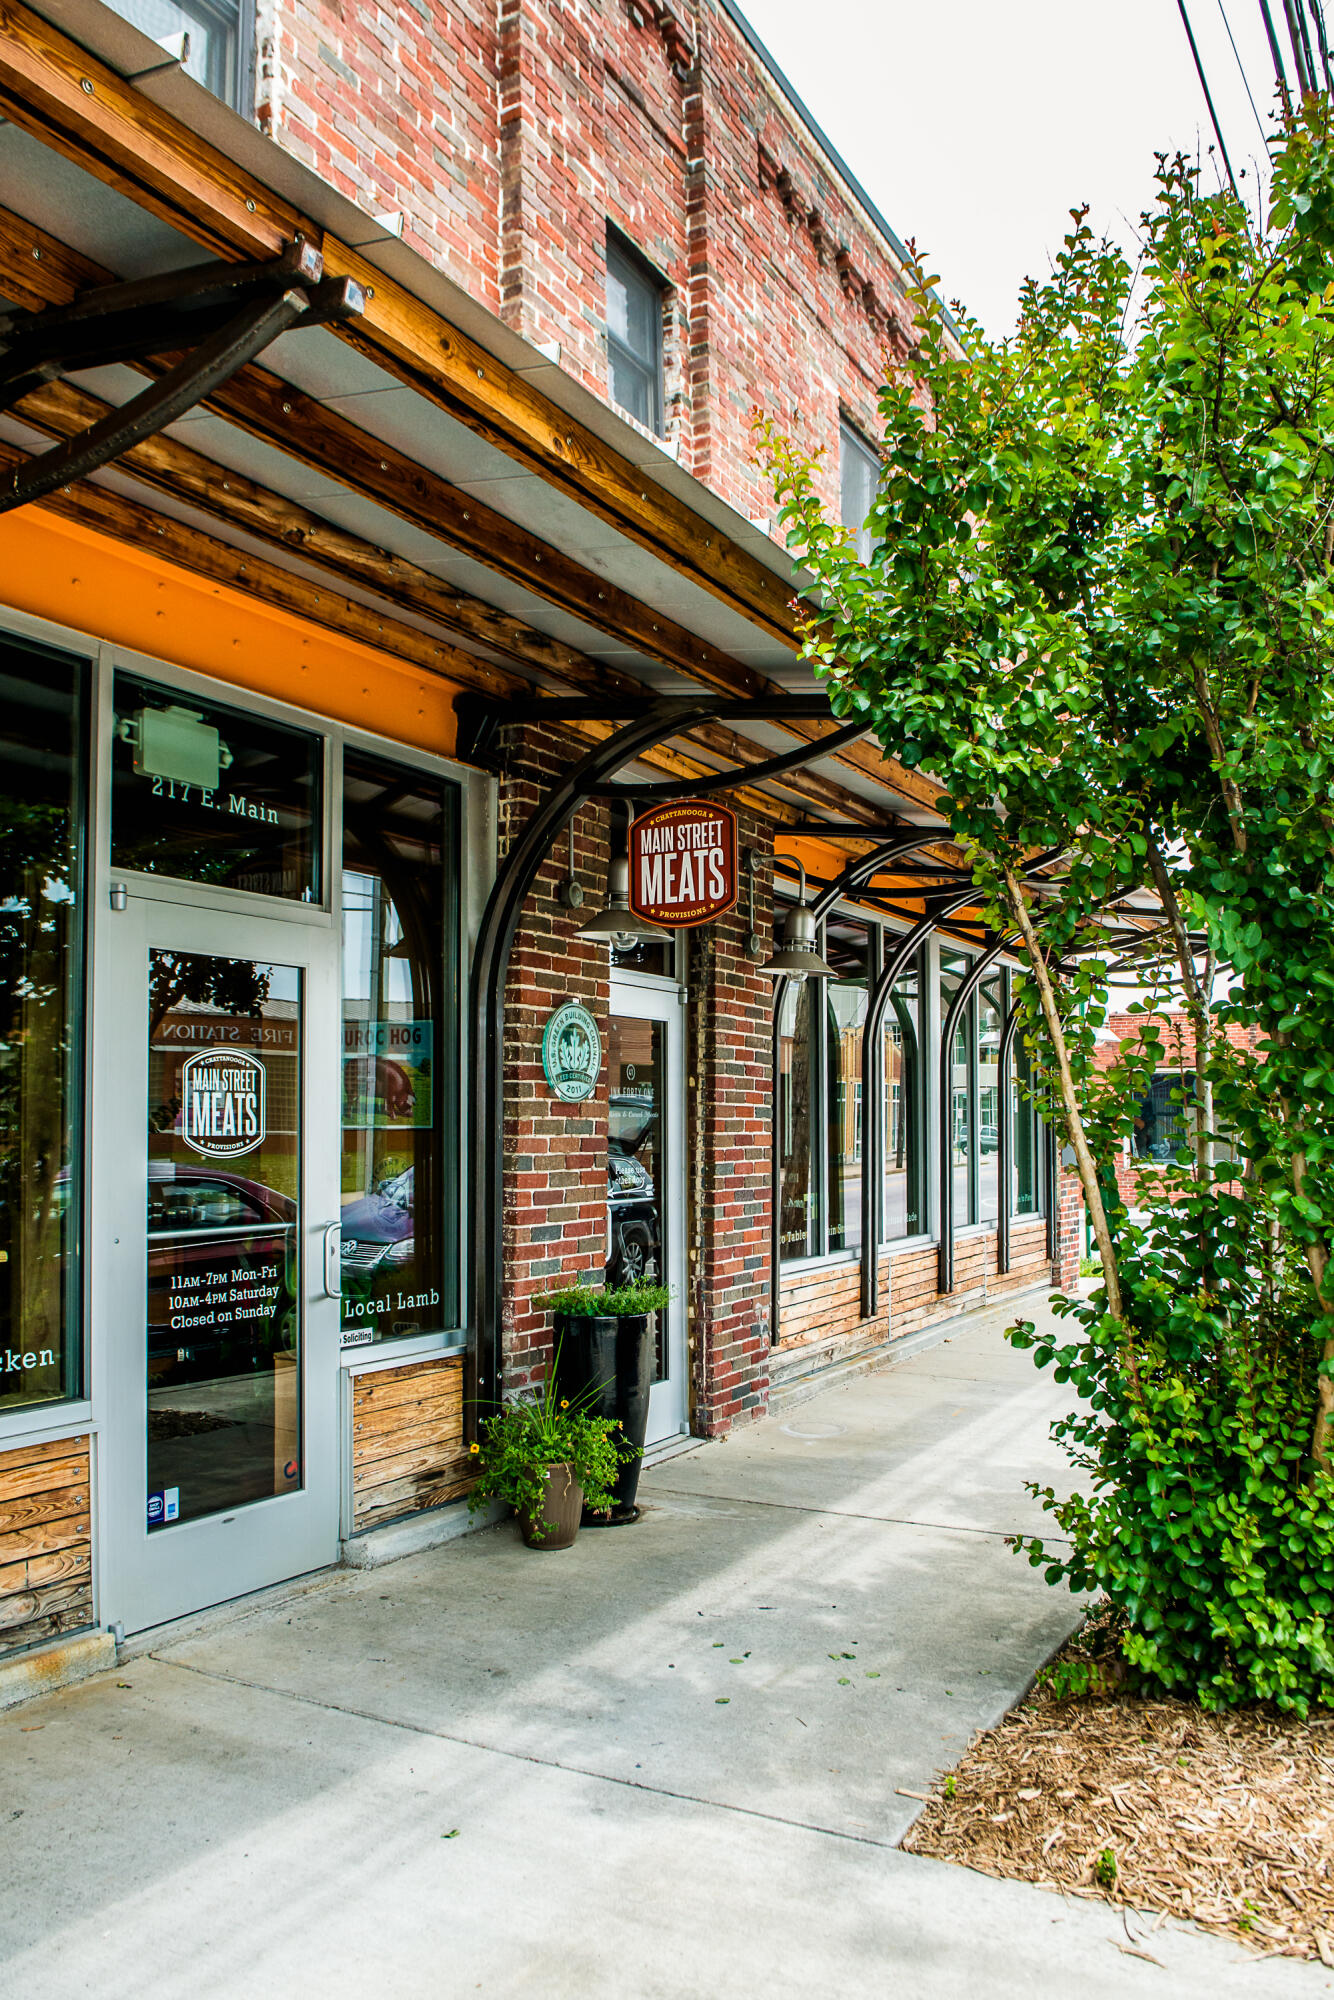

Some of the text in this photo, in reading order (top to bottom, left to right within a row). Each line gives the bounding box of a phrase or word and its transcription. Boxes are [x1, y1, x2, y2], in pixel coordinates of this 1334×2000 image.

[152, 775, 279, 824] 217 E. Main
[655, 809, 707, 823] CHATTANOOGA
[640, 820, 723, 854] MAIN STREET
[641, 847, 725, 906] MEATS
[659, 906, 707, 919] PROVISIONS
[341, 1027, 422, 1046] UROC HOG
[551, 1019, 564, 1047] GREEN
[564, 1011, 590, 1029] BUILDING
[589, 1029, 597, 1071] COUNCIL
[204, 1055, 246, 1066] CHATTANOOGA
[192, 1068, 257, 1092] MAIN STREET
[566, 1085, 582, 1094] 2011
[192, 1092, 257, 1137] MEATS
[206, 1141, 244, 1150] PROVISIONS
[170, 1265, 278, 1290] 11AM-7PM Mon-Fri
[169, 1284, 280, 1310] 10AM-4PM Saturday
[344, 1287, 440, 1318] Local Lamb
[171, 1304, 277, 1329] Closed on Sunday
[342, 1331, 373, 1344] Soliciting
